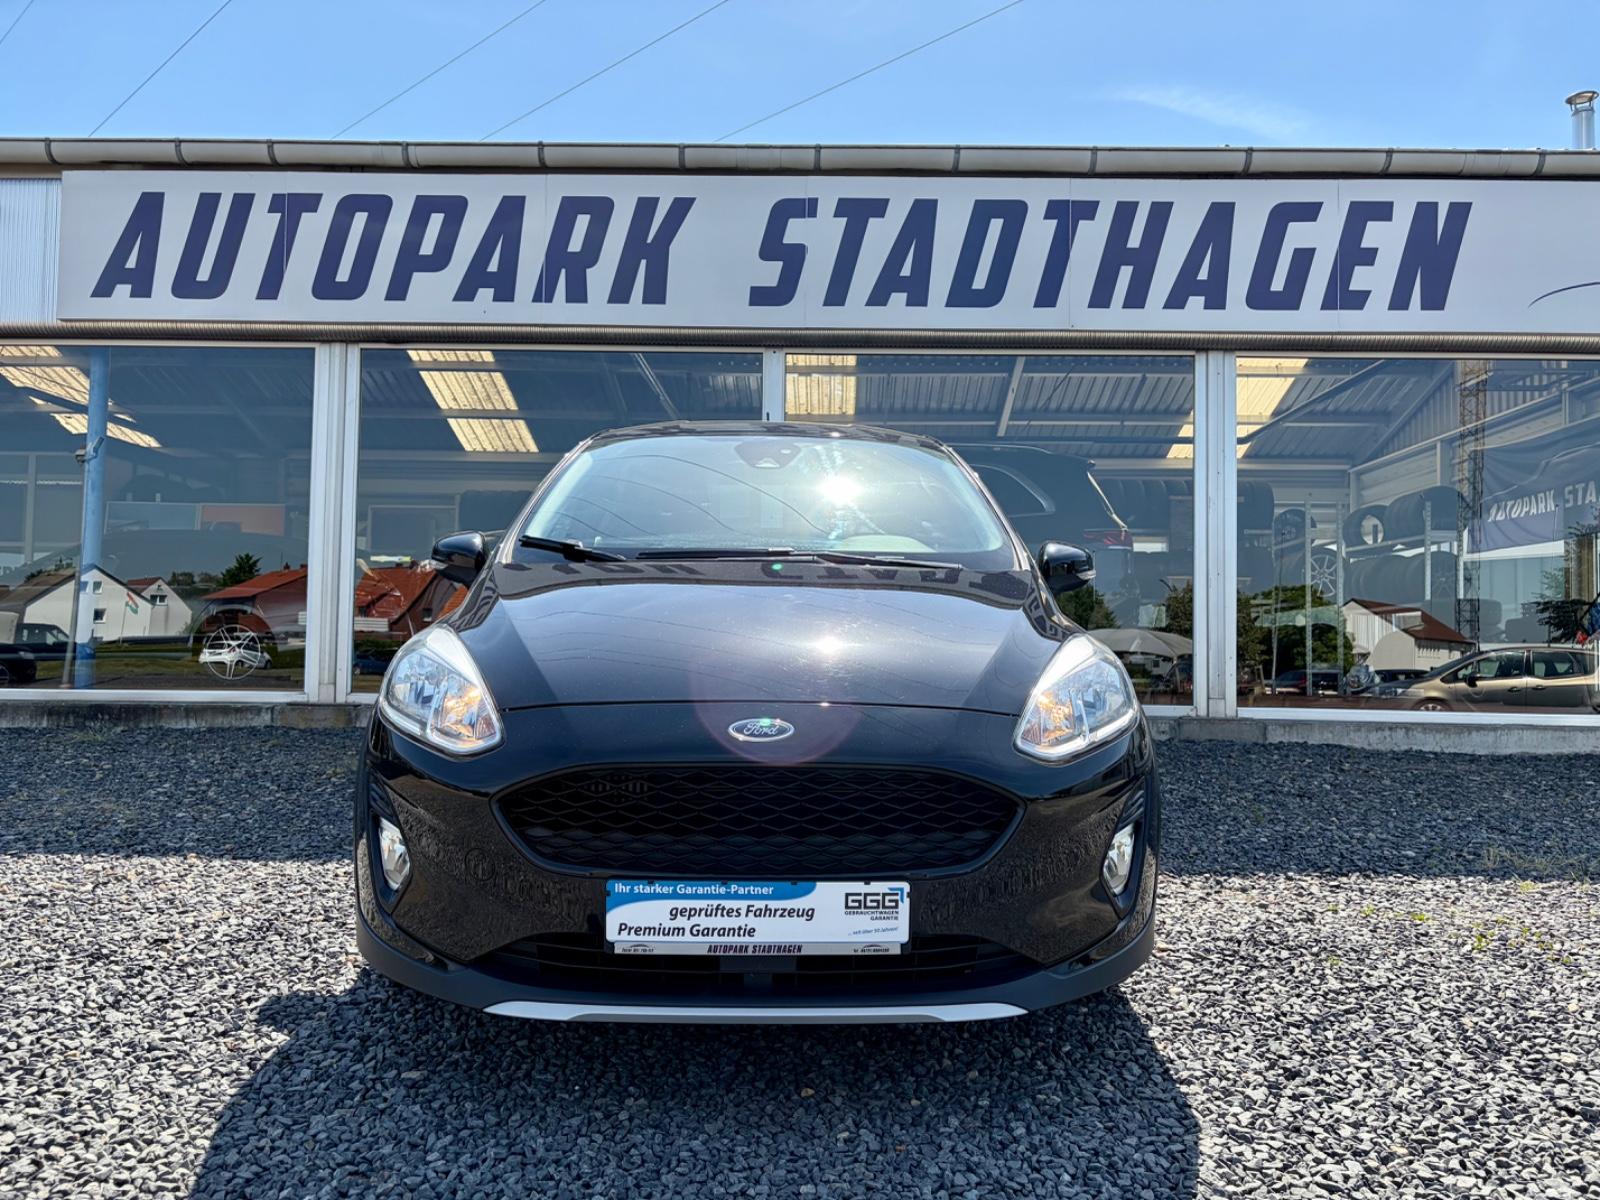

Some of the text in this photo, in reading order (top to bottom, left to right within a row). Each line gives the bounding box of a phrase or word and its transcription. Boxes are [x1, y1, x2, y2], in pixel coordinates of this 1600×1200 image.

[91, 191, 1473, 311] AUTOPARK STADTHAGEN
[1563, 480, 1600, 508] STA
[614, 883, 774, 895] Ihr starker Garantie-Partner
[844, 892, 900, 910] GGG
[669, 903, 816, 922] geprüftes Fahrzeug
[617, 922, 757, 938] Premium Garantie
[707, 944, 803, 954] AUTOPARK STADTHAGEN
